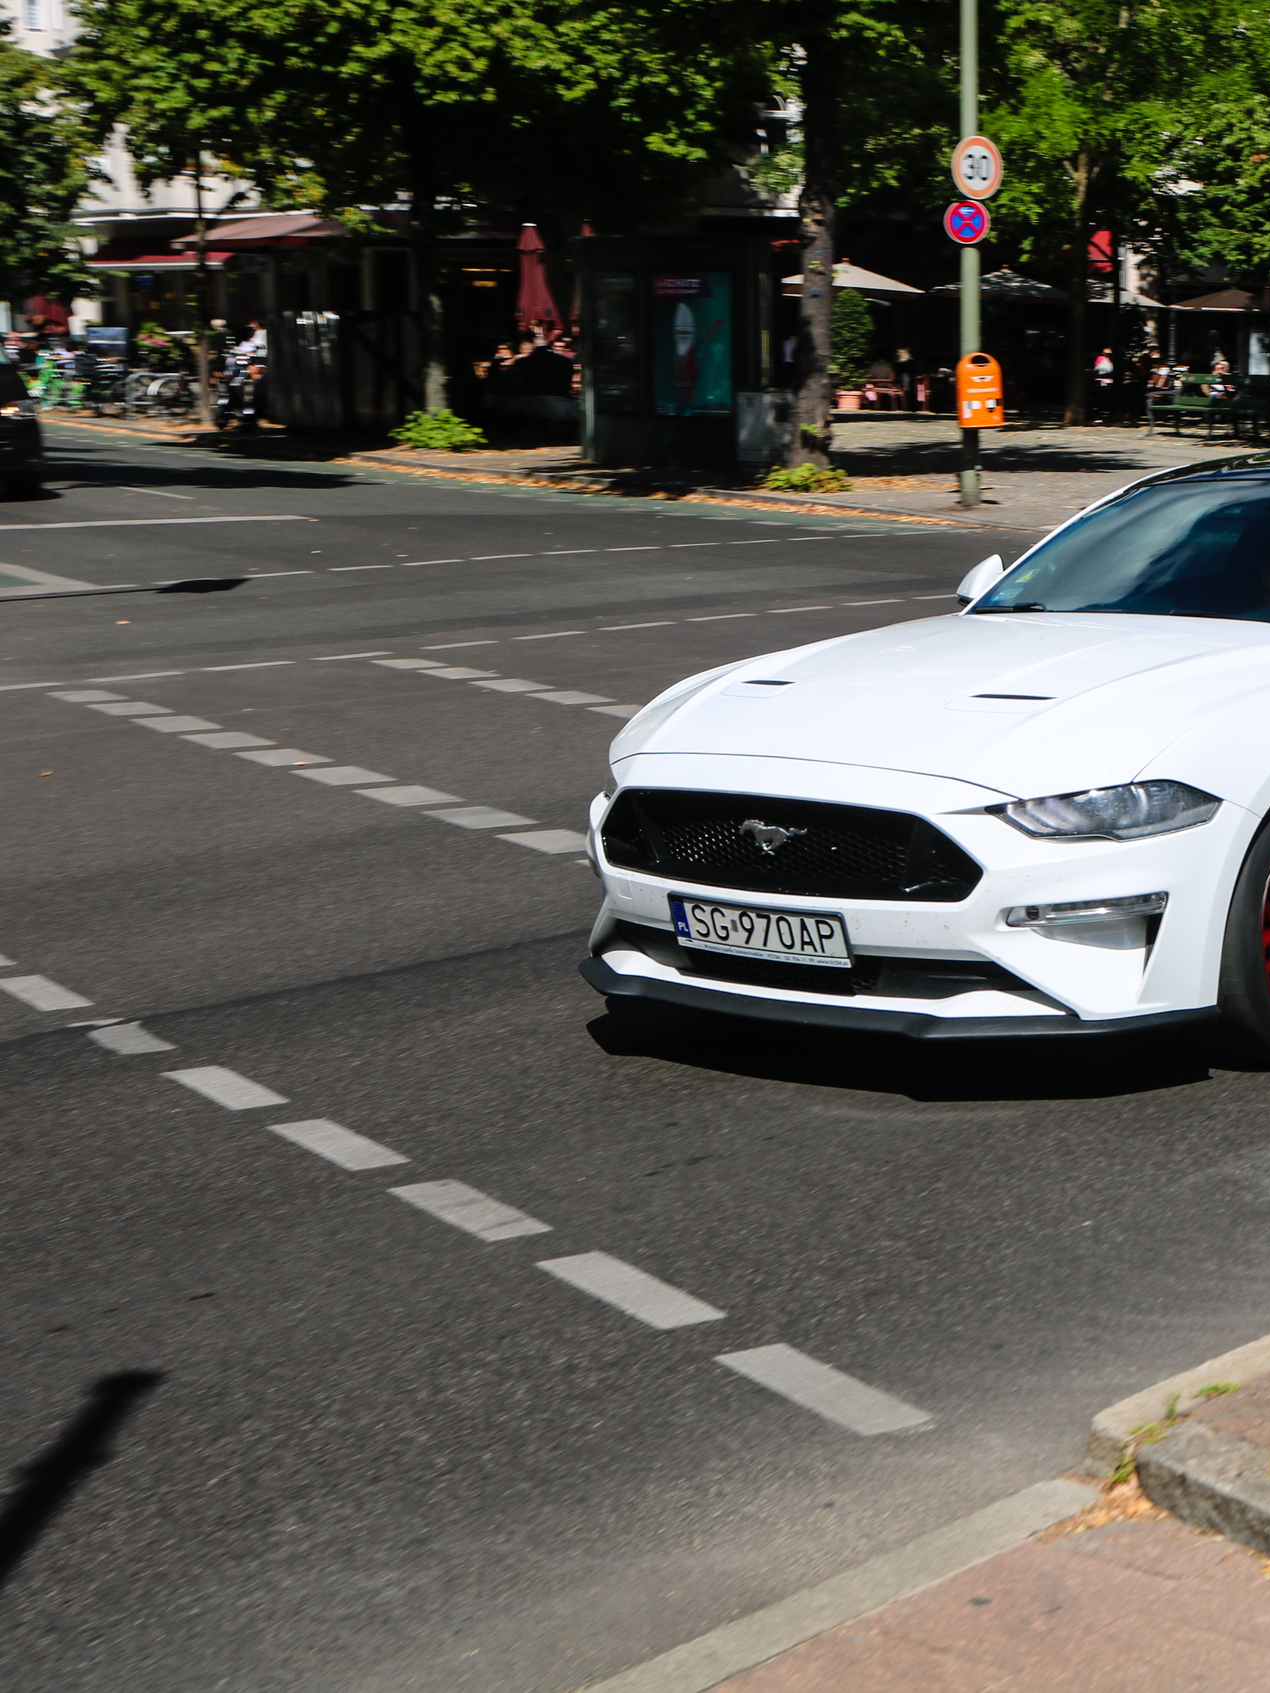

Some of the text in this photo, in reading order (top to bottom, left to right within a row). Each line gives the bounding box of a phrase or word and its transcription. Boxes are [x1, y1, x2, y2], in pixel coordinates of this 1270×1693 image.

[962, 154, 994, 181] 30
[678, 921, 689, 932] PL
[691, 904, 835, 953] SG 970AP
